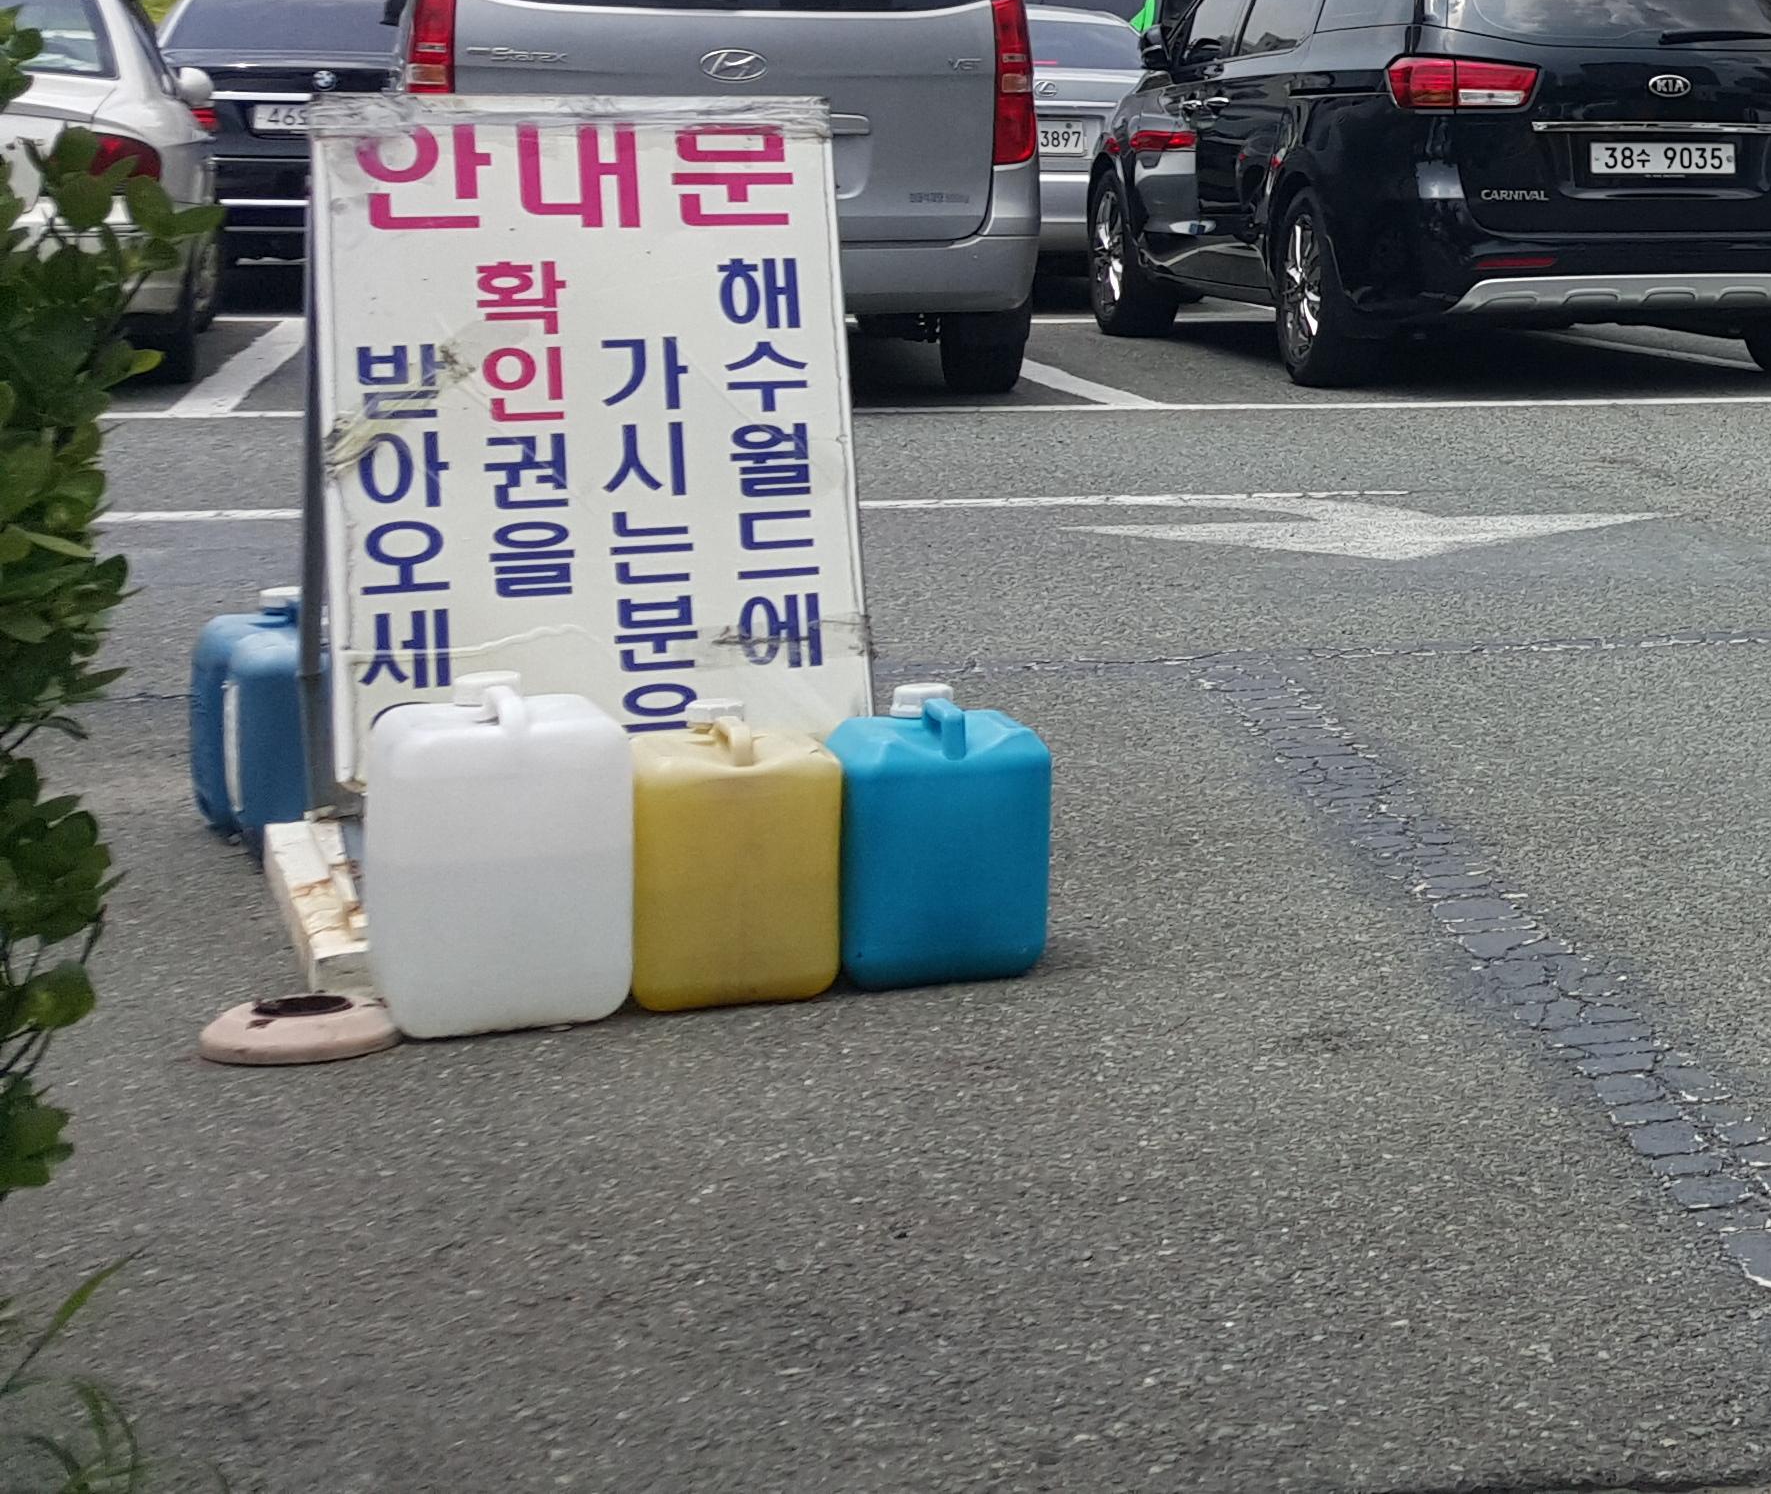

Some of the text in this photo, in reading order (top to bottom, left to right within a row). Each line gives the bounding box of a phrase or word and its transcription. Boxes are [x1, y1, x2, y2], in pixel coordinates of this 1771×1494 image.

[1655, 79, 1685, 93] KIA
[1040, 130, 1081, 147] 3897
[1604, 146, 1724, 169] 38수 9035
[355, 122, 797, 229] 안내문
[1481, 189, 1549, 201] CARNIVAL
[716, 257, 822, 669] 해수월드에
[355, 343, 452, 696] 받아오세
